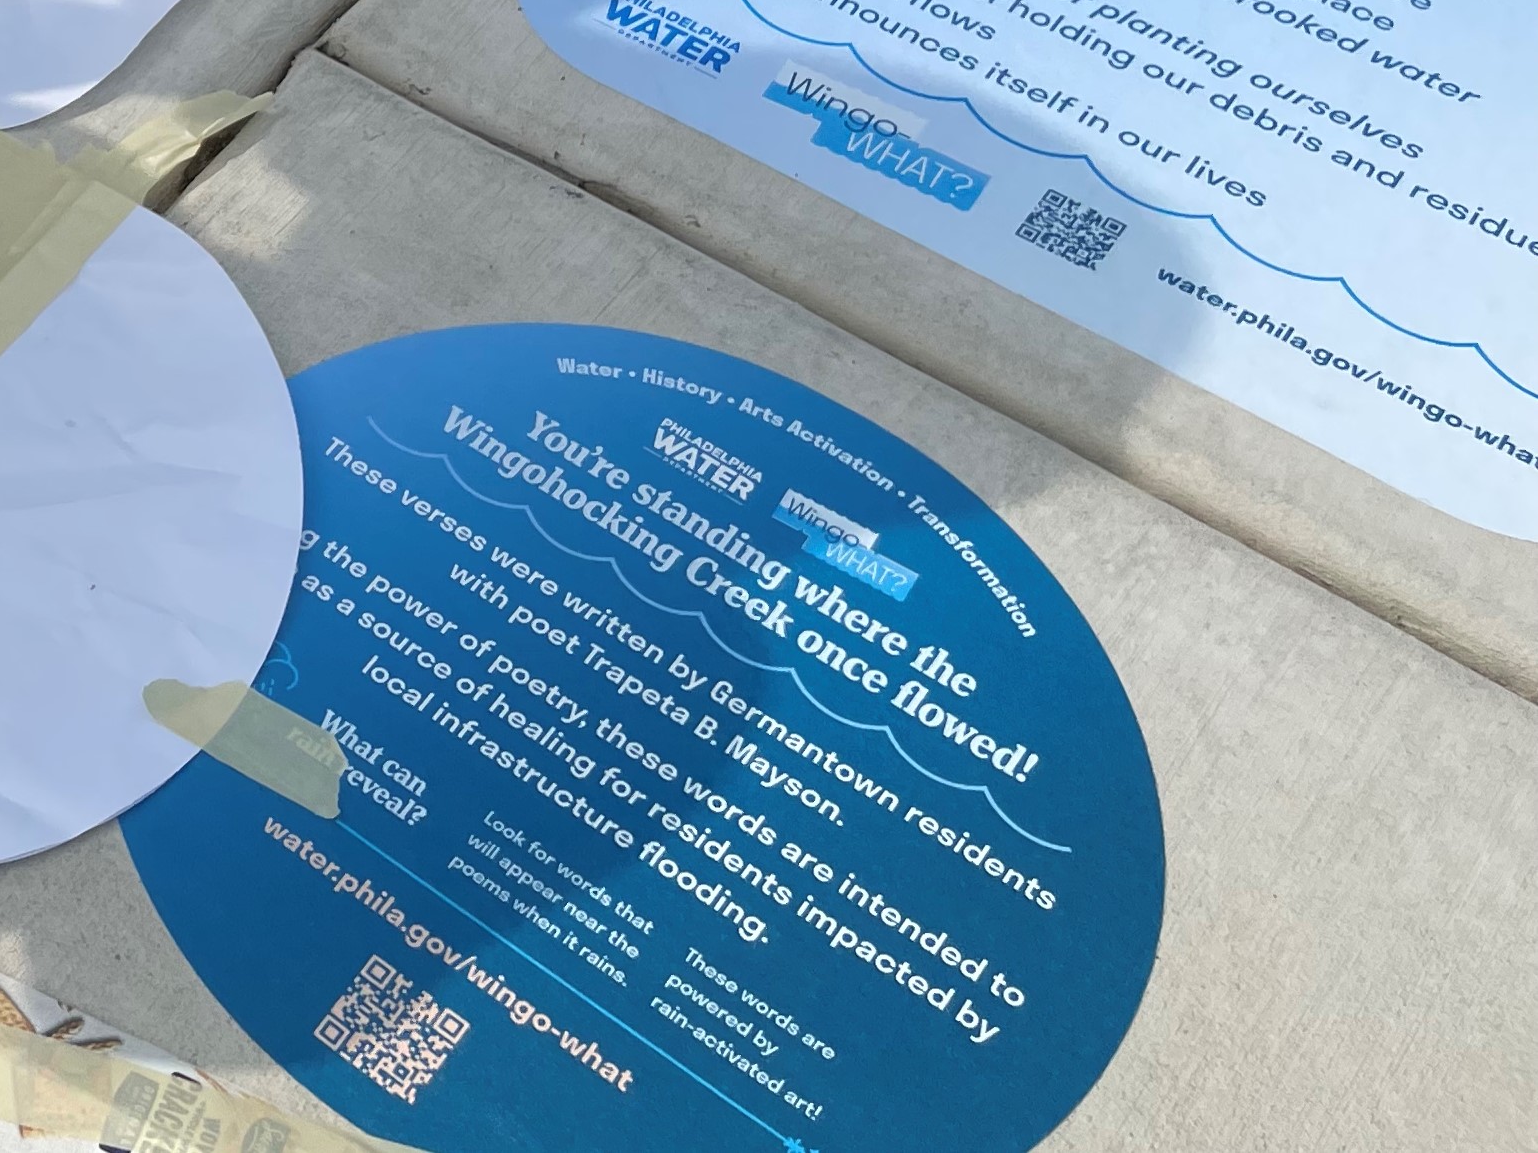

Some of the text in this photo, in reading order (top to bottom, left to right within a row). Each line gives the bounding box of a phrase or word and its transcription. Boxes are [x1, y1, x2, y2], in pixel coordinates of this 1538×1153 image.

[786, 72, 912, 139] Wingo-
[846, 132, 974, 198] WHAT?
[984, 61, 1080, 114] itself
[1077, 104, 1110, 134] in
[1117, 130, 1182, 163] our
[1184, 155, 1267, 207] lives
[557, 358, 1036, 638] Water History Arts Activation Transformation
[654, 427, 755, 501] WATER
[660, 417, 763, 483] PHILADELPHIA
[443, 405, 685, 573] Wingohocking
[686, 556, 795, 639] Creek
[796, 629, 889, 694] once
[889, 680, 1040, 783] flowed!
[526, 410, 630, 490] You're
[631, 483, 793, 591] standing
[793, 574, 909, 656] where
[909, 645, 978, 698] the
[825, 543, 907, 592] WHAT?
[325, 436, 1057, 910] These verses were written by Germantown residents
[449, 563, 844, 828] with poet Trapeta B. Mayson.
[321, 708, 427, 798] What can
[447, 855, 628, 988] poems when it rains.
[467, 834, 640, 960] will appear near the
[483, 810, 655, 936] Look for words that
[264, 816, 634, 1093] water.phila.gov/wingo-what
[663, 974, 780, 1057] powered by
[685, 946, 836, 1060] These words are
[649, 996, 824, 1122] rain-activated art!
